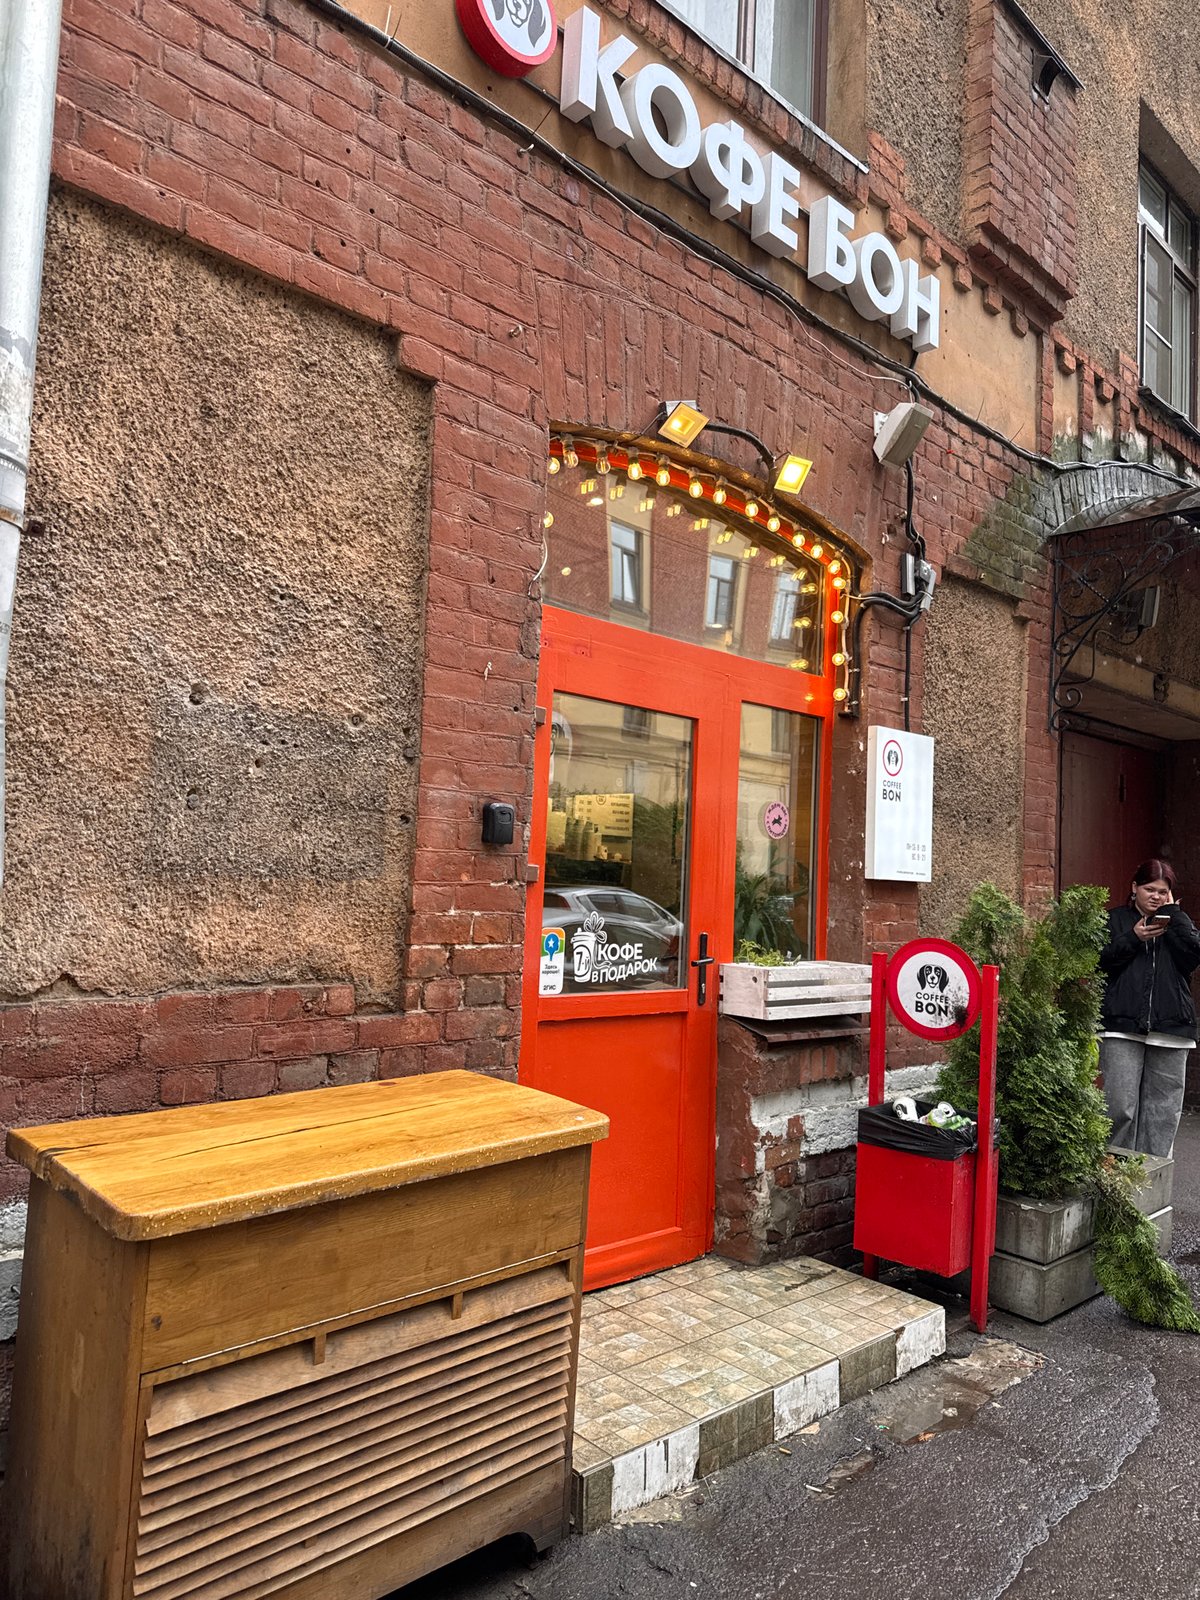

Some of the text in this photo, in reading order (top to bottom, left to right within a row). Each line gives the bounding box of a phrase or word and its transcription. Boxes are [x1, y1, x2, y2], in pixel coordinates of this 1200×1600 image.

[560, 5, 940, 353] КОФЕ БОН
[882, 779, 902, 790] COFFEE
[882, 788, 901, 802] BON
[597, 942, 643, 961] КОФЕ
[600, 957, 658, 983] ПОДАРОК
[915, 991, 949, 1005] COFFEE
[915, 1000, 949, 1017] BON
